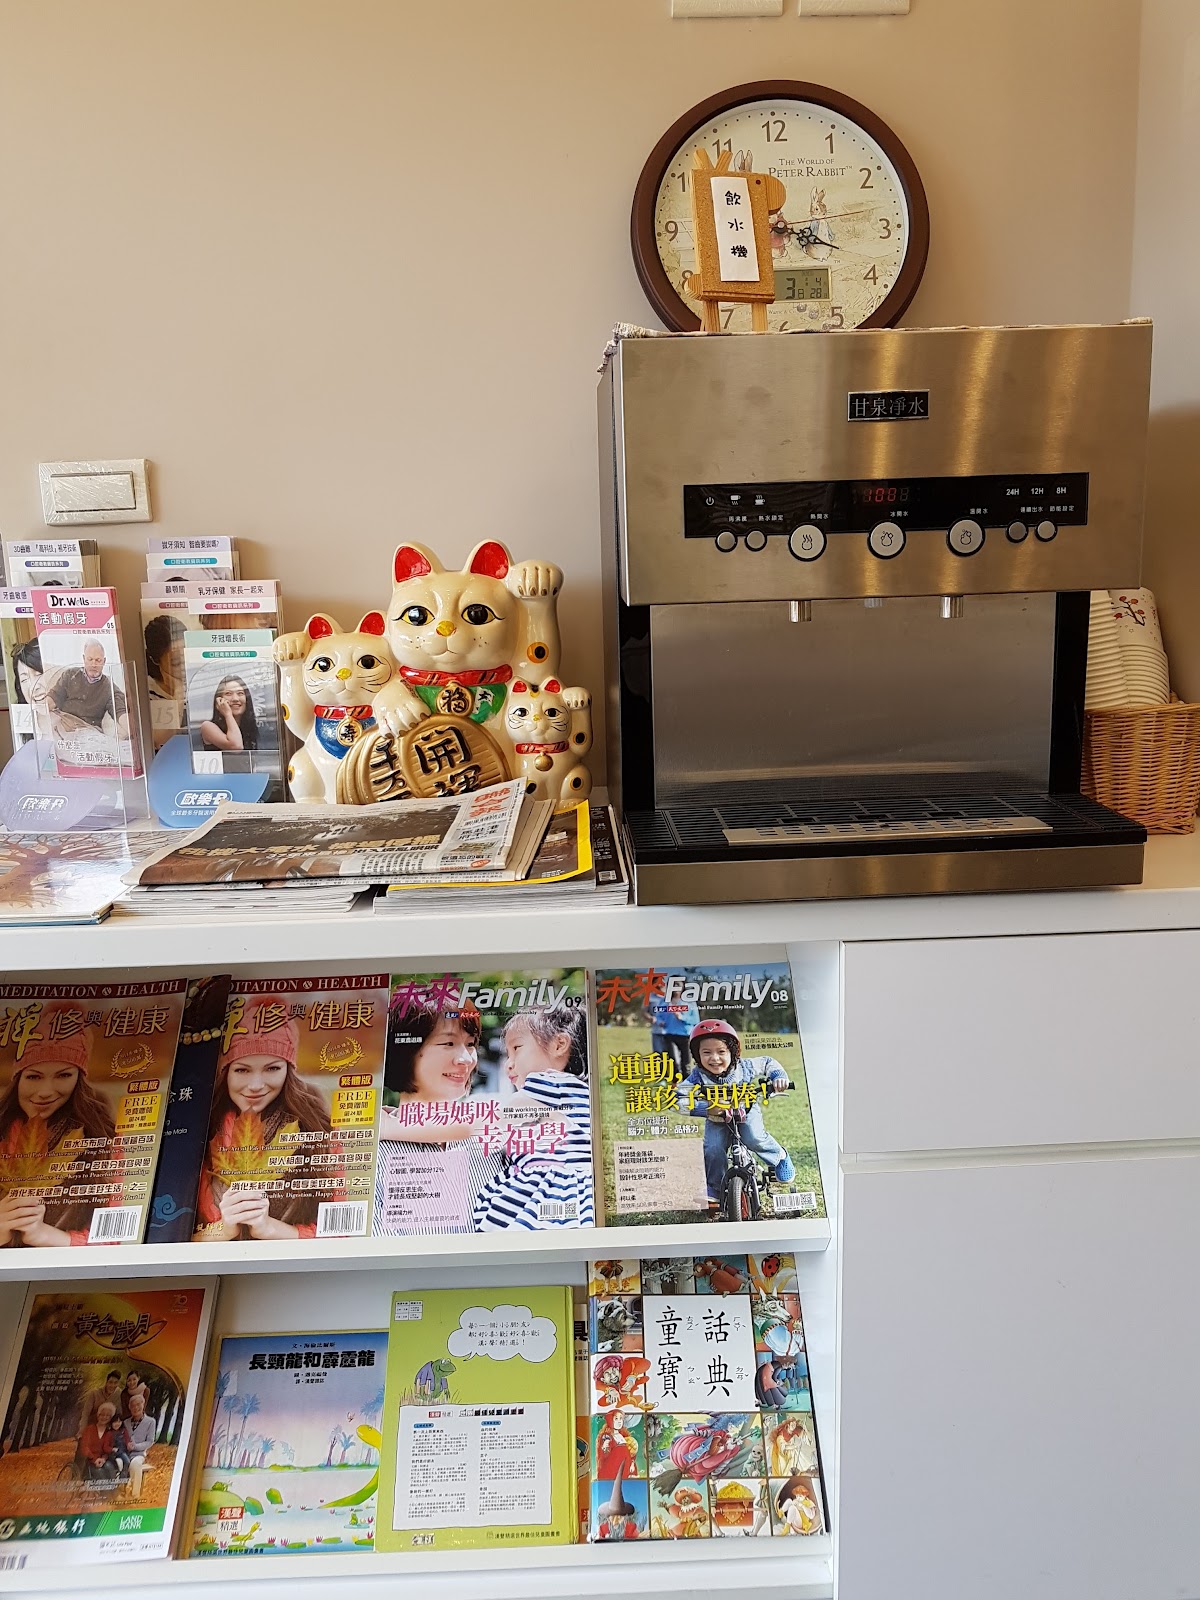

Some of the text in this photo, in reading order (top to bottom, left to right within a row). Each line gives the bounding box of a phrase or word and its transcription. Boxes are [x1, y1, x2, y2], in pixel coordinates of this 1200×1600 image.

[762, 119, 788, 143] 12
[824, 133, 835, 154] 1
[768, 166, 804, 178] PETER
[859, 168, 873, 189] 2
[664, 220, 679, 241] 9
[724, 190, 748, 259] 飲水機
[878, 218, 892, 239] 3
[863, 264, 879, 285] 4
[720, 308, 735, 329] 7
[831, 306, 844, 328] 5
[851, 396, 925, 417] 甘泉淨水
[1006, 488, 1020, 496] 24H
[1031, 487, 1044, 495] 12H
[1056, 486, 1067, 494] 8H
[38, 612, 88, 625] 活動假牙
[156, 706, 174, 725] 15
[117, 981, 180, 996] HEALTH
[318, 976, 382, 989] HEALTH
[596, 967, 789, 1013] 未來 Family 08
[457, 978, 569, 1014] Family
[564, 996, 582, 1008] 09
[124, 1095, 158, 1108] FREE
[337, 1090, 373, 1102] FREE
[399, 1099, 501, 1128] 職場媽咪
[515, 1106, 538, 1114] working
[627, 1116, 669, 1127] 全方位提升
[474, 1122, 568, 1158] 幸福學
[656, 1305, 731, 1347] 童話
[119, 1522, 142, 1531] BANK
[121, 1515, 143, 1523] LAND
